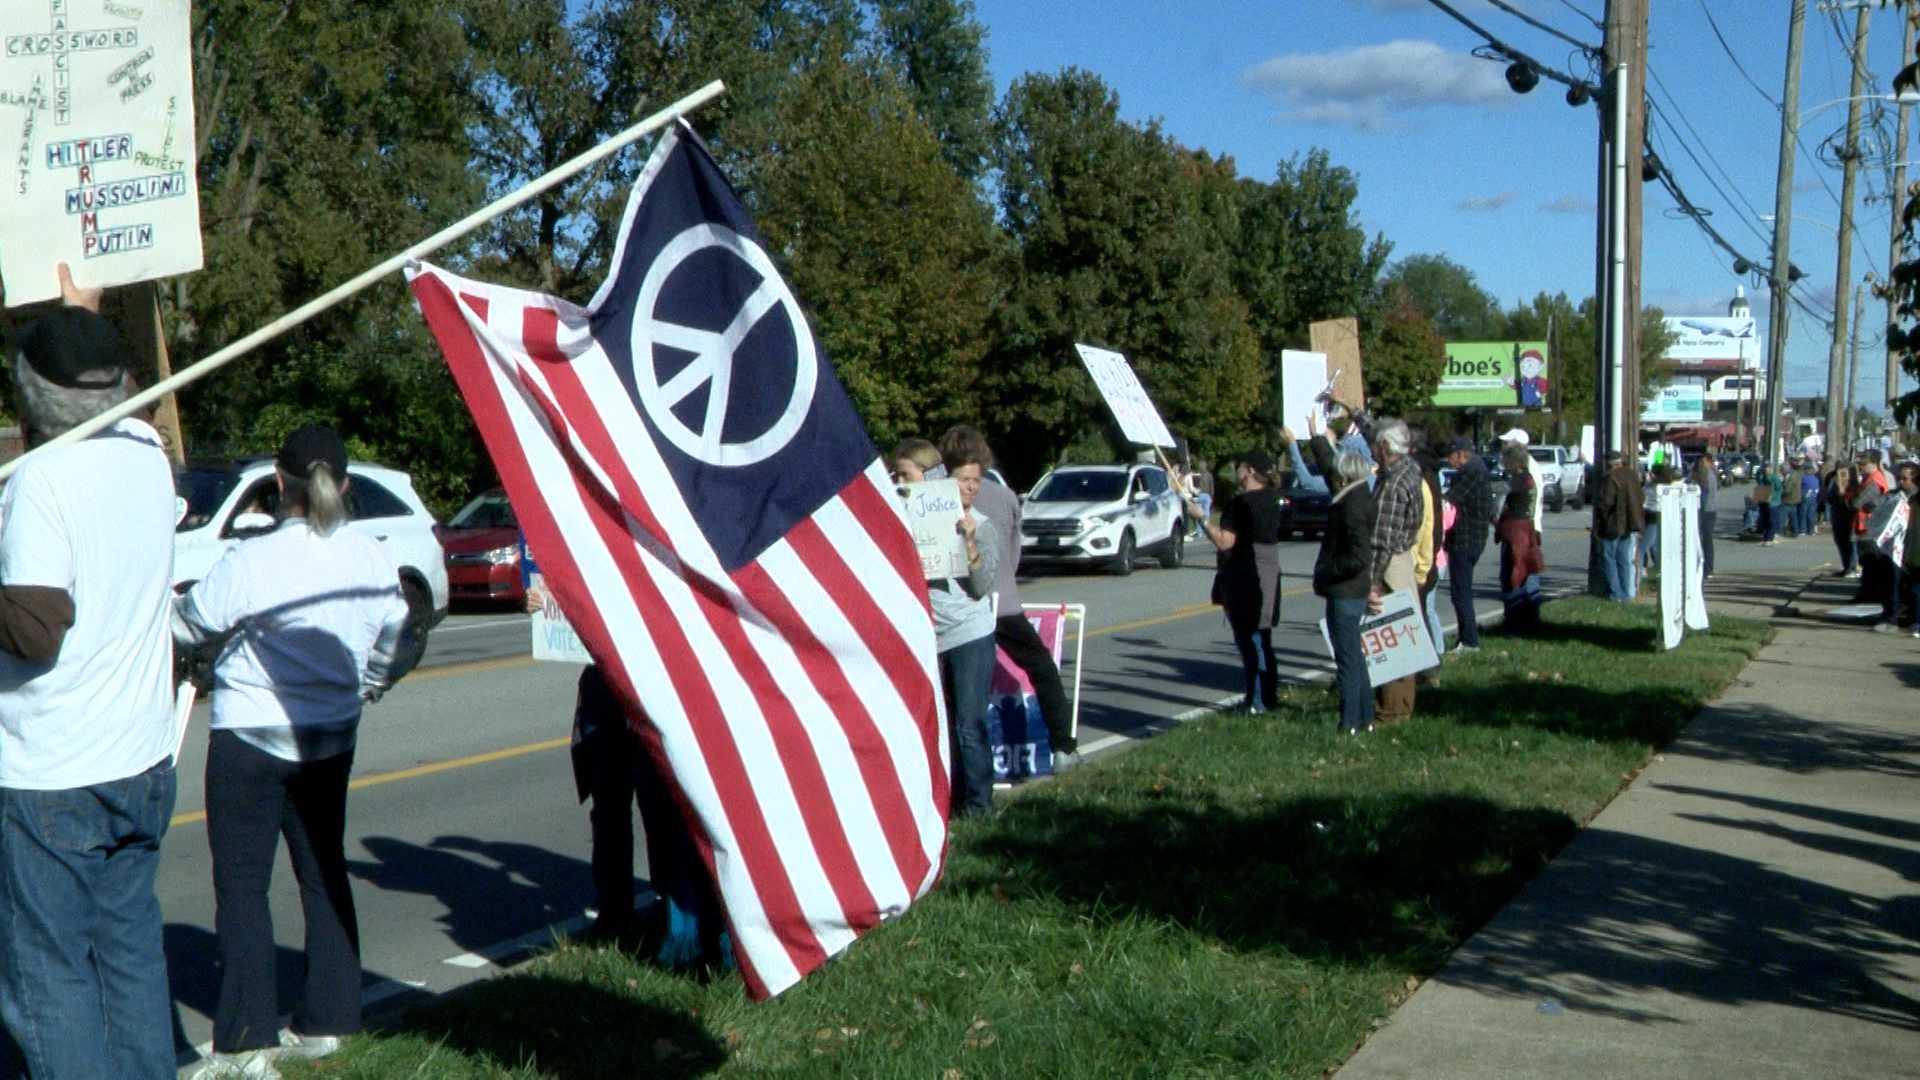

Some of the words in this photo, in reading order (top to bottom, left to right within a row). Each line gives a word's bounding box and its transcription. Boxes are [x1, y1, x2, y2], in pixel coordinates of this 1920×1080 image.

[8, 31, 136, 55] CROSSWORD
[52, 0, 69, 121] FASCIST
[50, 137, 130, 162] HITLER
[134, 151, 184, 172] PROTEST
[67, 178, 182, 209] MUSSOLINI
[79, 140, 98, 251] TRUMP
[86, 230, 151, 251] PUTIN
[1448, 355, 1502, 376] boe's
[916, 492, 958, 518] Justice
